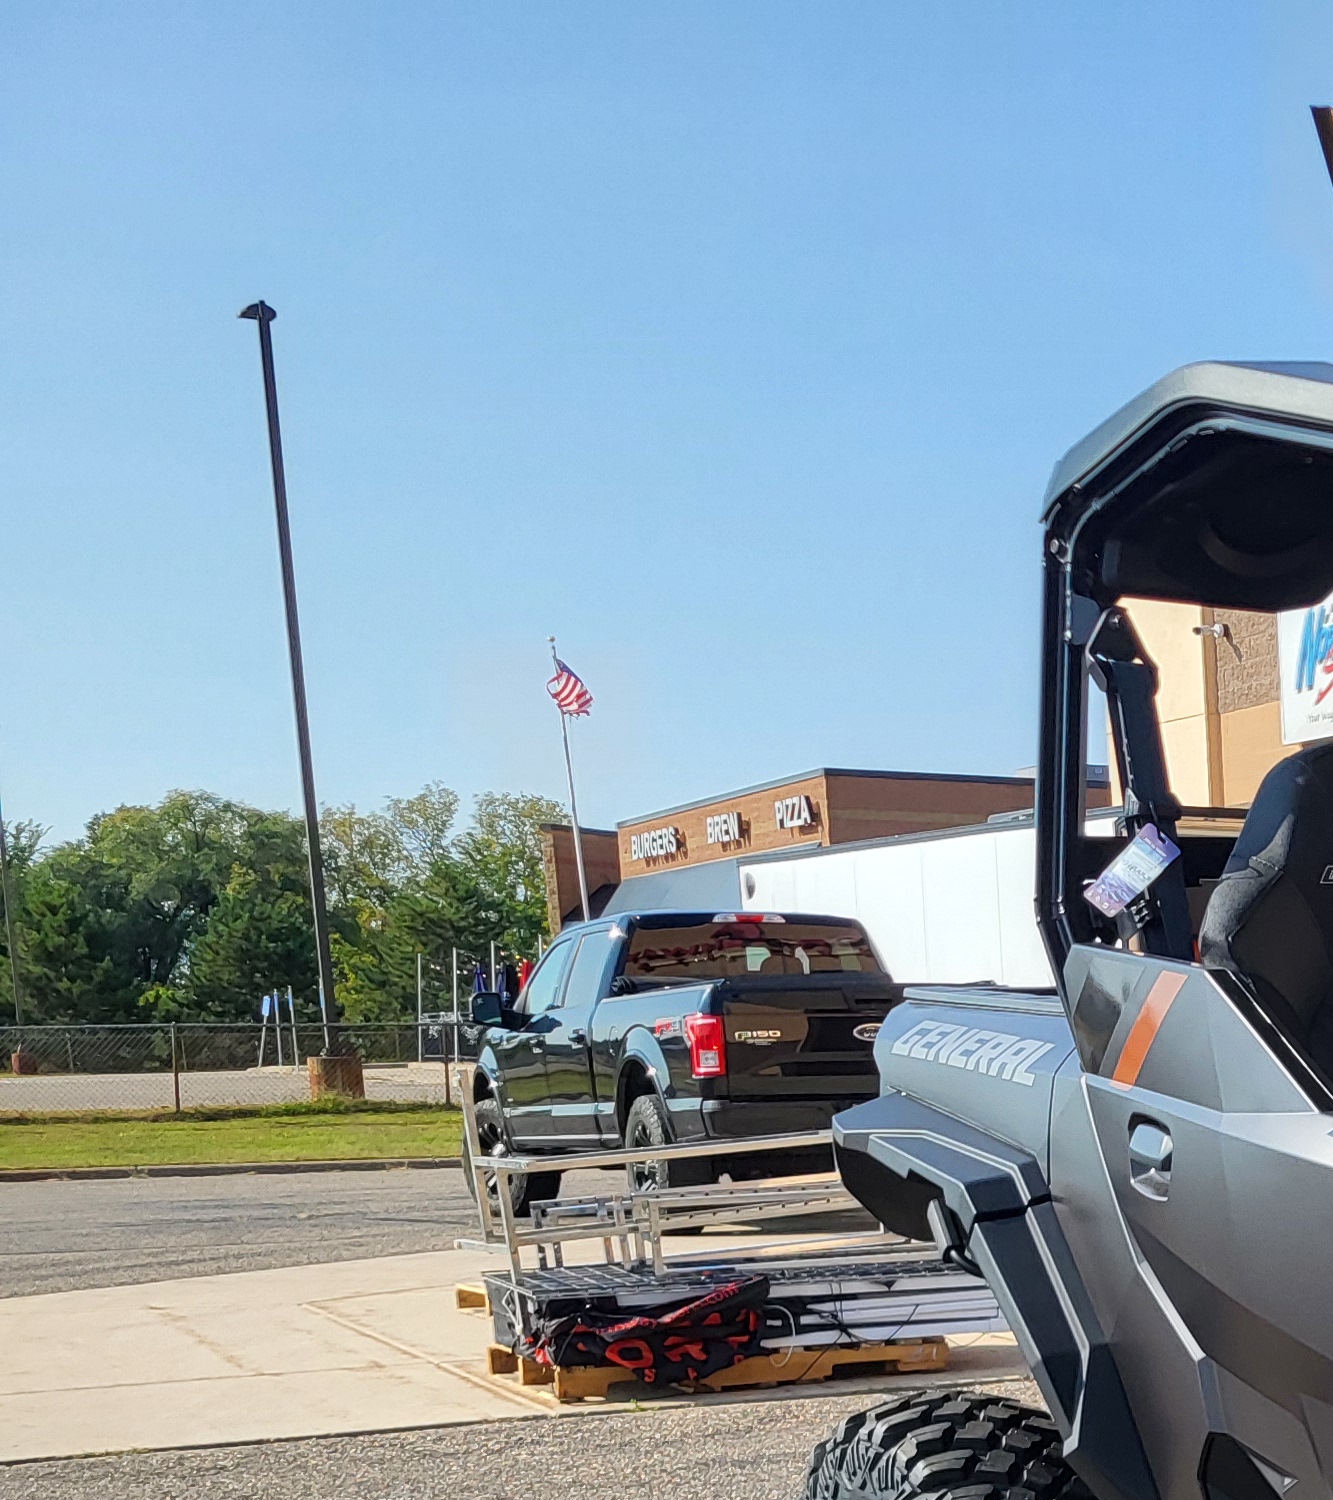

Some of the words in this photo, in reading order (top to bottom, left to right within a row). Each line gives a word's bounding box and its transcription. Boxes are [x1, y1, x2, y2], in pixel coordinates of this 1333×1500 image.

[706, 812, 740, 844] BREW
[774, 795, 811, 829] PIZZA
[631, 826, 677, 860] BURGERS
[890, 1019, 1055, 1087] GENERAL
